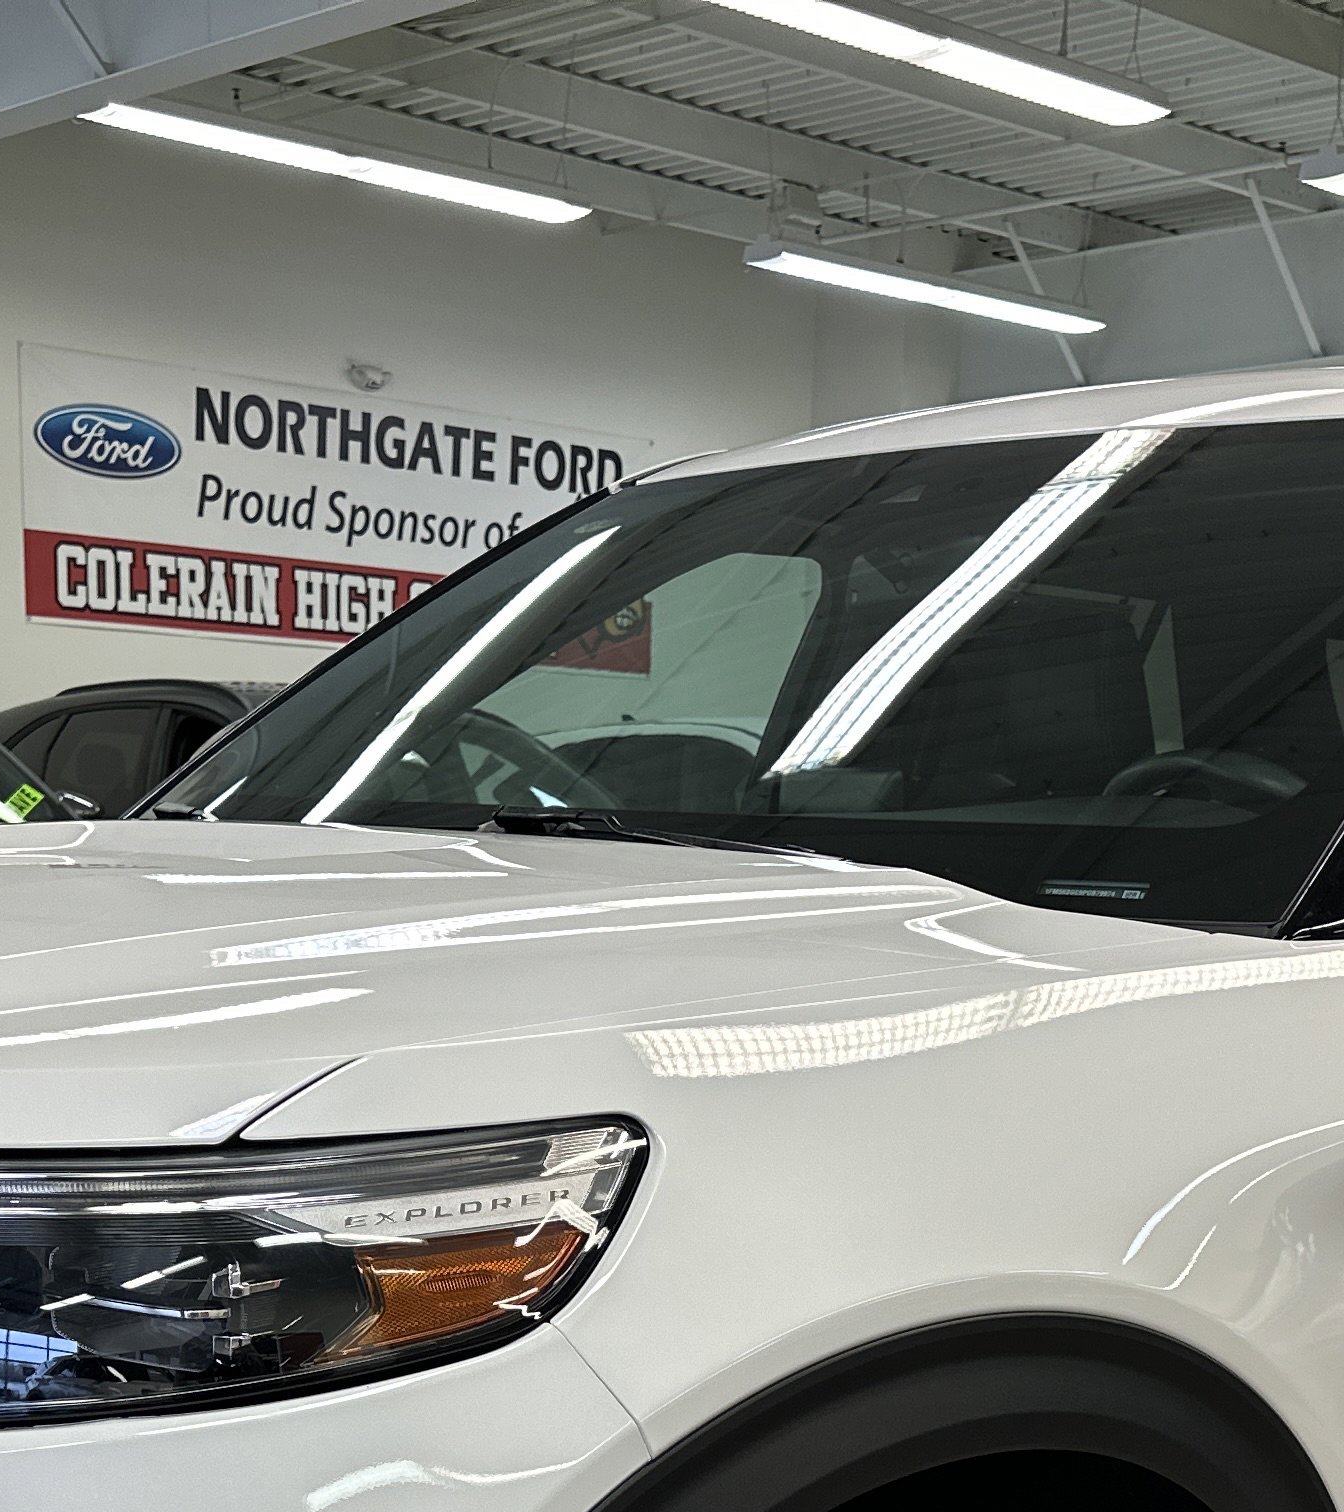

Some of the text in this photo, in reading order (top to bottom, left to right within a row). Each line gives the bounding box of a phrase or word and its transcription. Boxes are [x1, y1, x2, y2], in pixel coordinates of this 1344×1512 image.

[61, 413, 156, 469] Ford
[194, 386, 624, 495] NORTHGATE FORD
[197, 474, 523, 550] Proud Sponsor of
[55, 541, 398, 635] COLERAIN HIGH
[344, 1188, 572, 1229] EXPLORER
